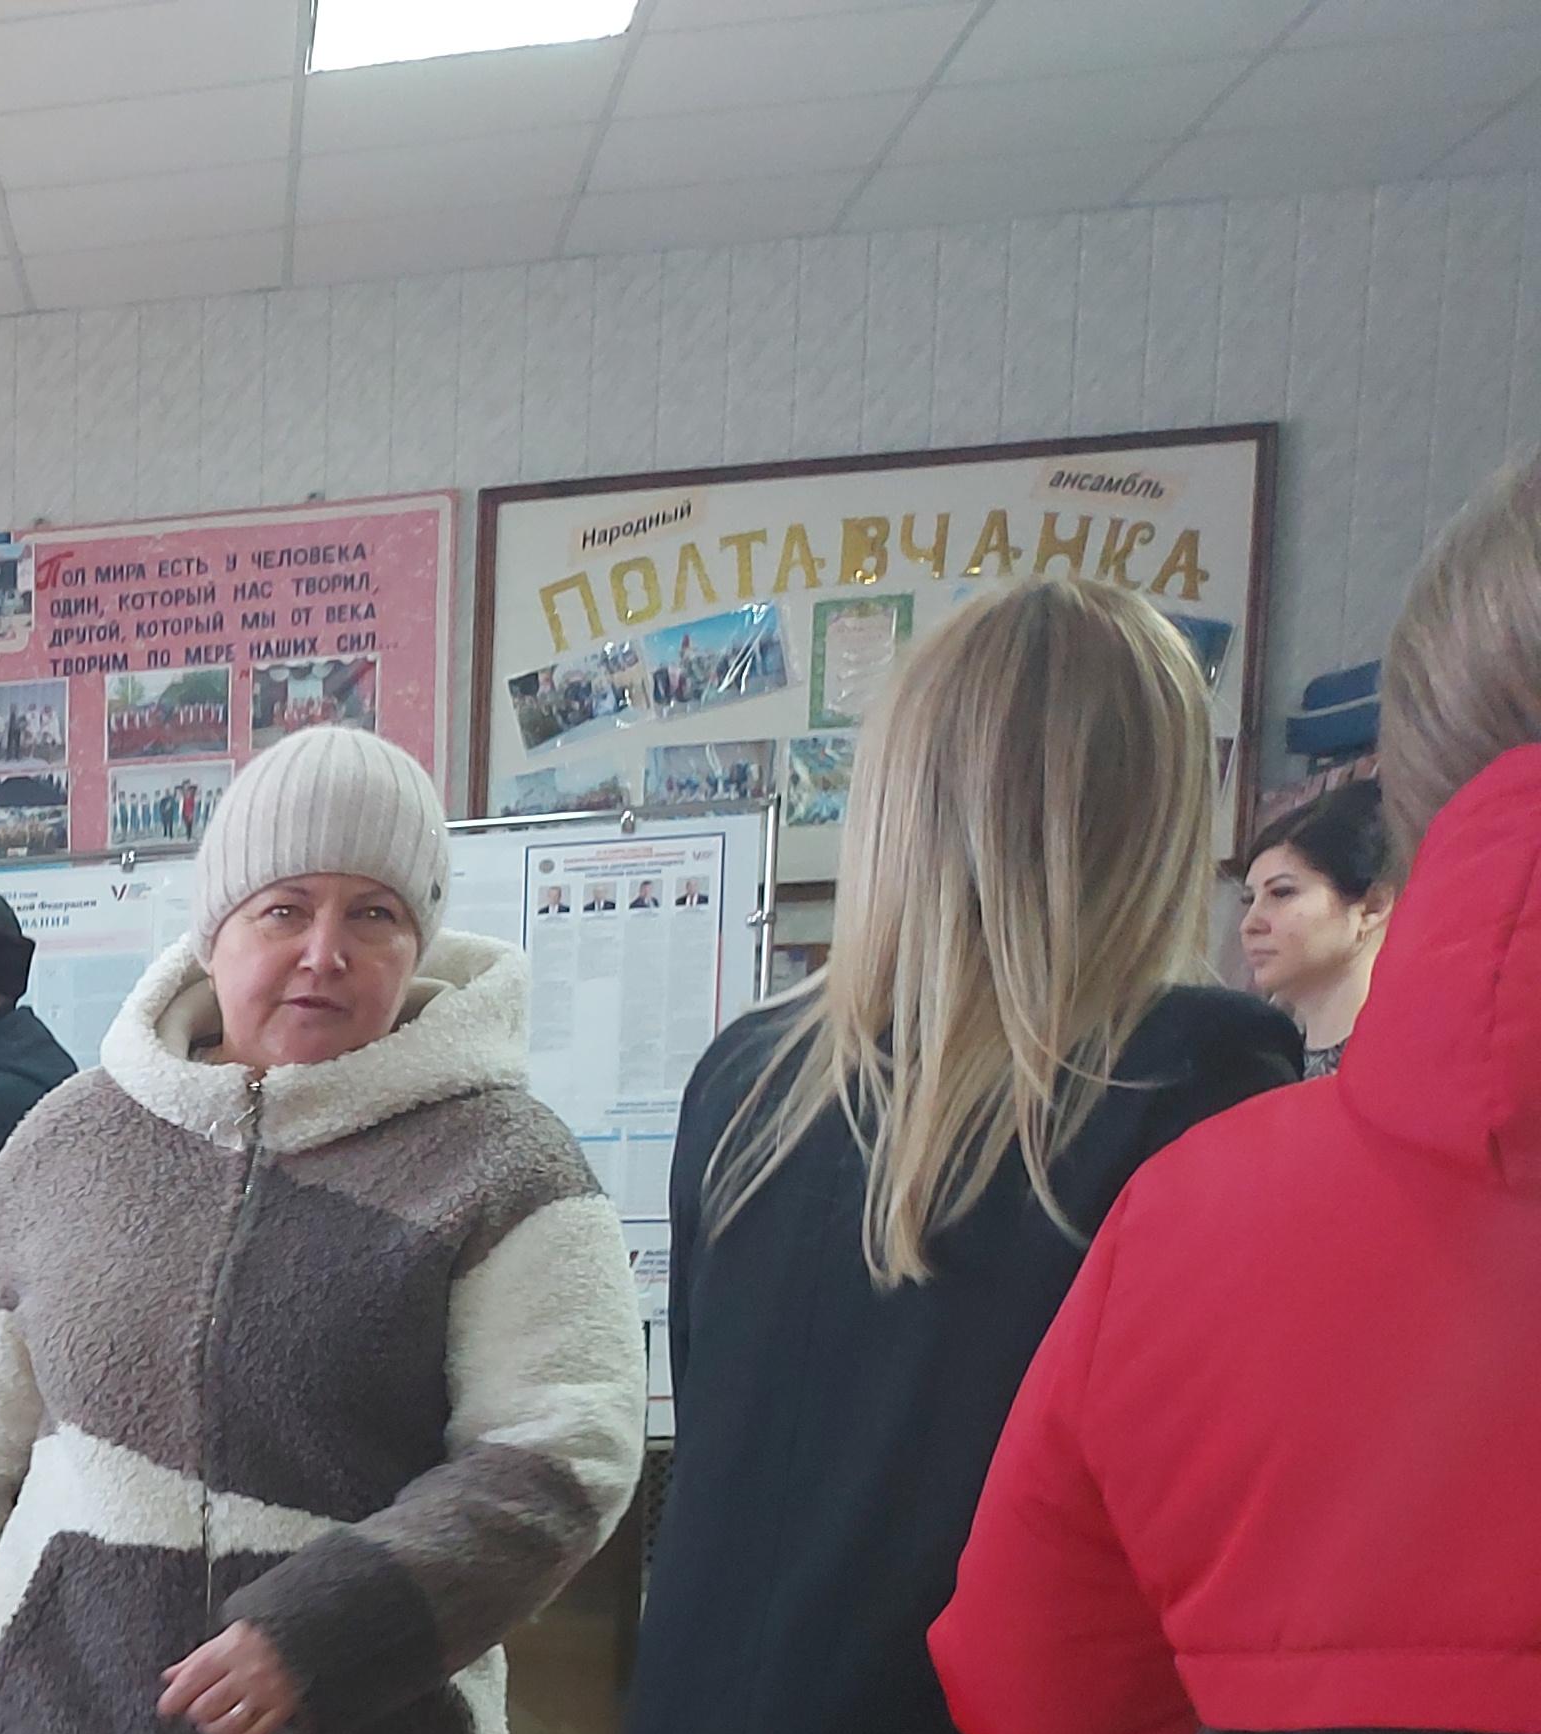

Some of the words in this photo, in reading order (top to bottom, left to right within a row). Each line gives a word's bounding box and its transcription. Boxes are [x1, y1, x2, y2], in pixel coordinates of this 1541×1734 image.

[1048, 468, 1165, 501] ансамбль
[581, 498, 692, 551] Народный
[95, 563, 146, 584] МИРА
[158, 557, 209, 578] ЕСТЬ
[225, 553, 237, 573] У
[539, 508, 1210, 653] ПОЛТАВЧАНКА
[50, 596, 105, 619] ОДИН,
[119, 581, 216, 612] КОТОРЫЙ
[233, 581, 273, 602] НАС
[292, 572, 379, 597] ТВОРИЛ,
[49, 619, 126, 648] ДРУГОЙ,
[136, 611, 224, 639] КОТОРЫЙ
[241, 610, 276, 630] МЫ
[291, 607, 313, 626] ОТ
[325, 603, 376, 624] ВЕКА
[49, 653, 128, 677] ТВОРИМ
[147, 649, 171, 668] ПО
[184, 643, 236, 665] МЕРЕ
[249, 636, 318, 659] НАШИХ
